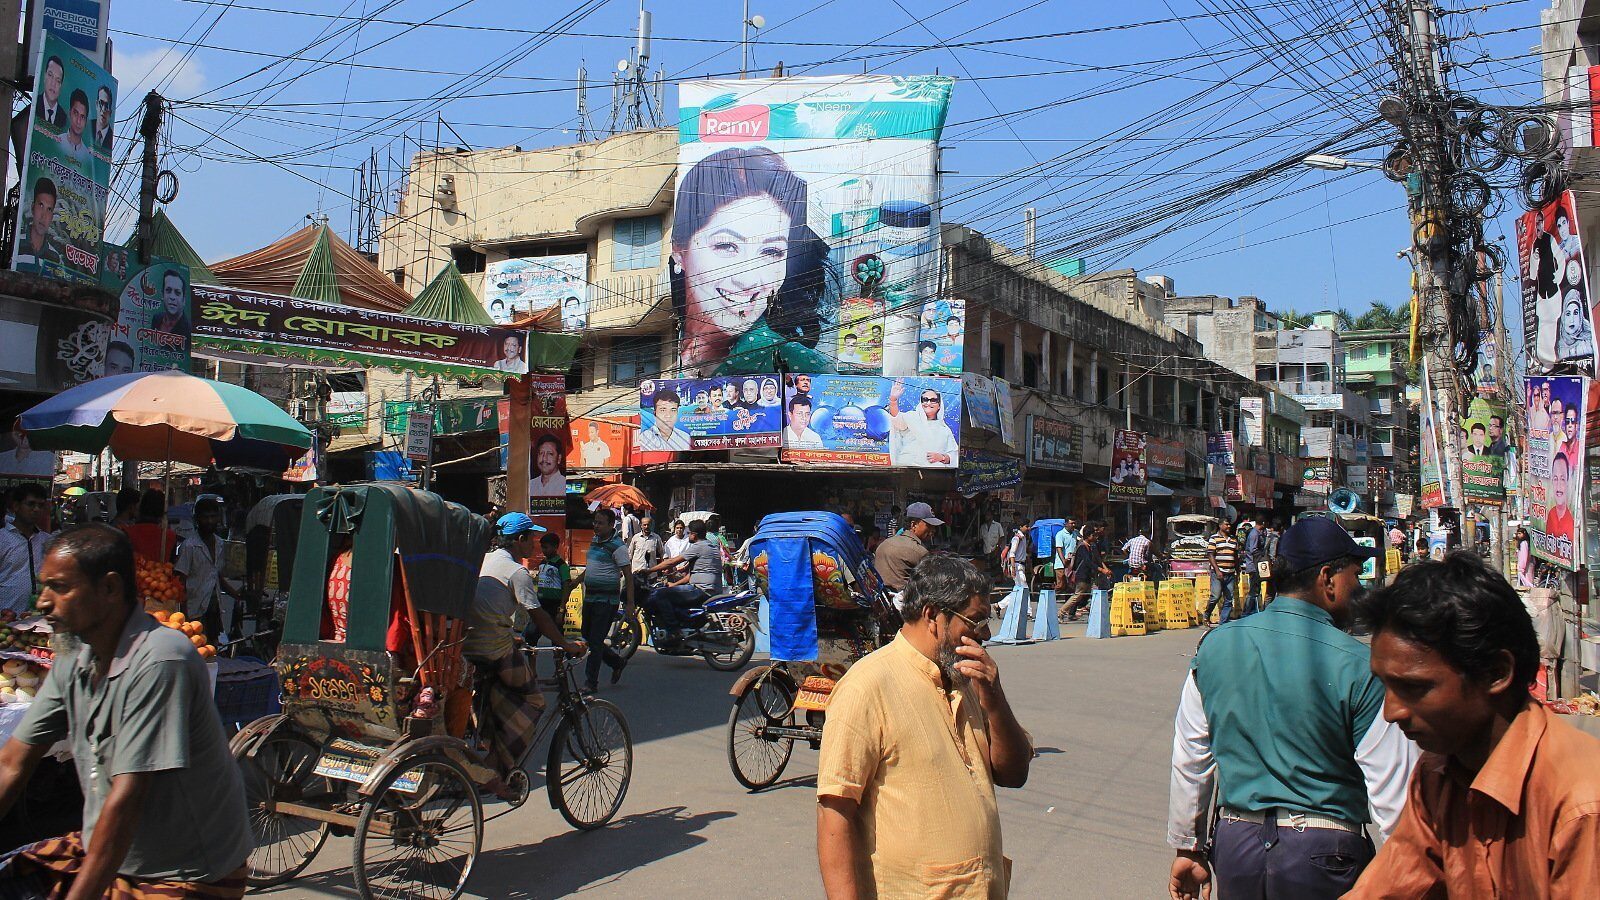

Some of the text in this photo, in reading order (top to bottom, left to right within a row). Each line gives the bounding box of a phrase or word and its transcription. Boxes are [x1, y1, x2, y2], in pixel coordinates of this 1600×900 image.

[43, 8, 97, 27] AMERICAN
[54, 19, 98, 37] EXPRESS
[816, 102, 851, 112] Neem
[706, 118, 762, 138] Ramy
[855, 123, 872, 131] FACE
[193, 287, 232, 302] ঈদুল
[291, 299, 352, 316] উপলক্ষে
[448, 322, 491, 336] জানাই
[200, 301, 459, 349] ঈদ মোবারক
[531, 416, 565, 430] মোবারক
